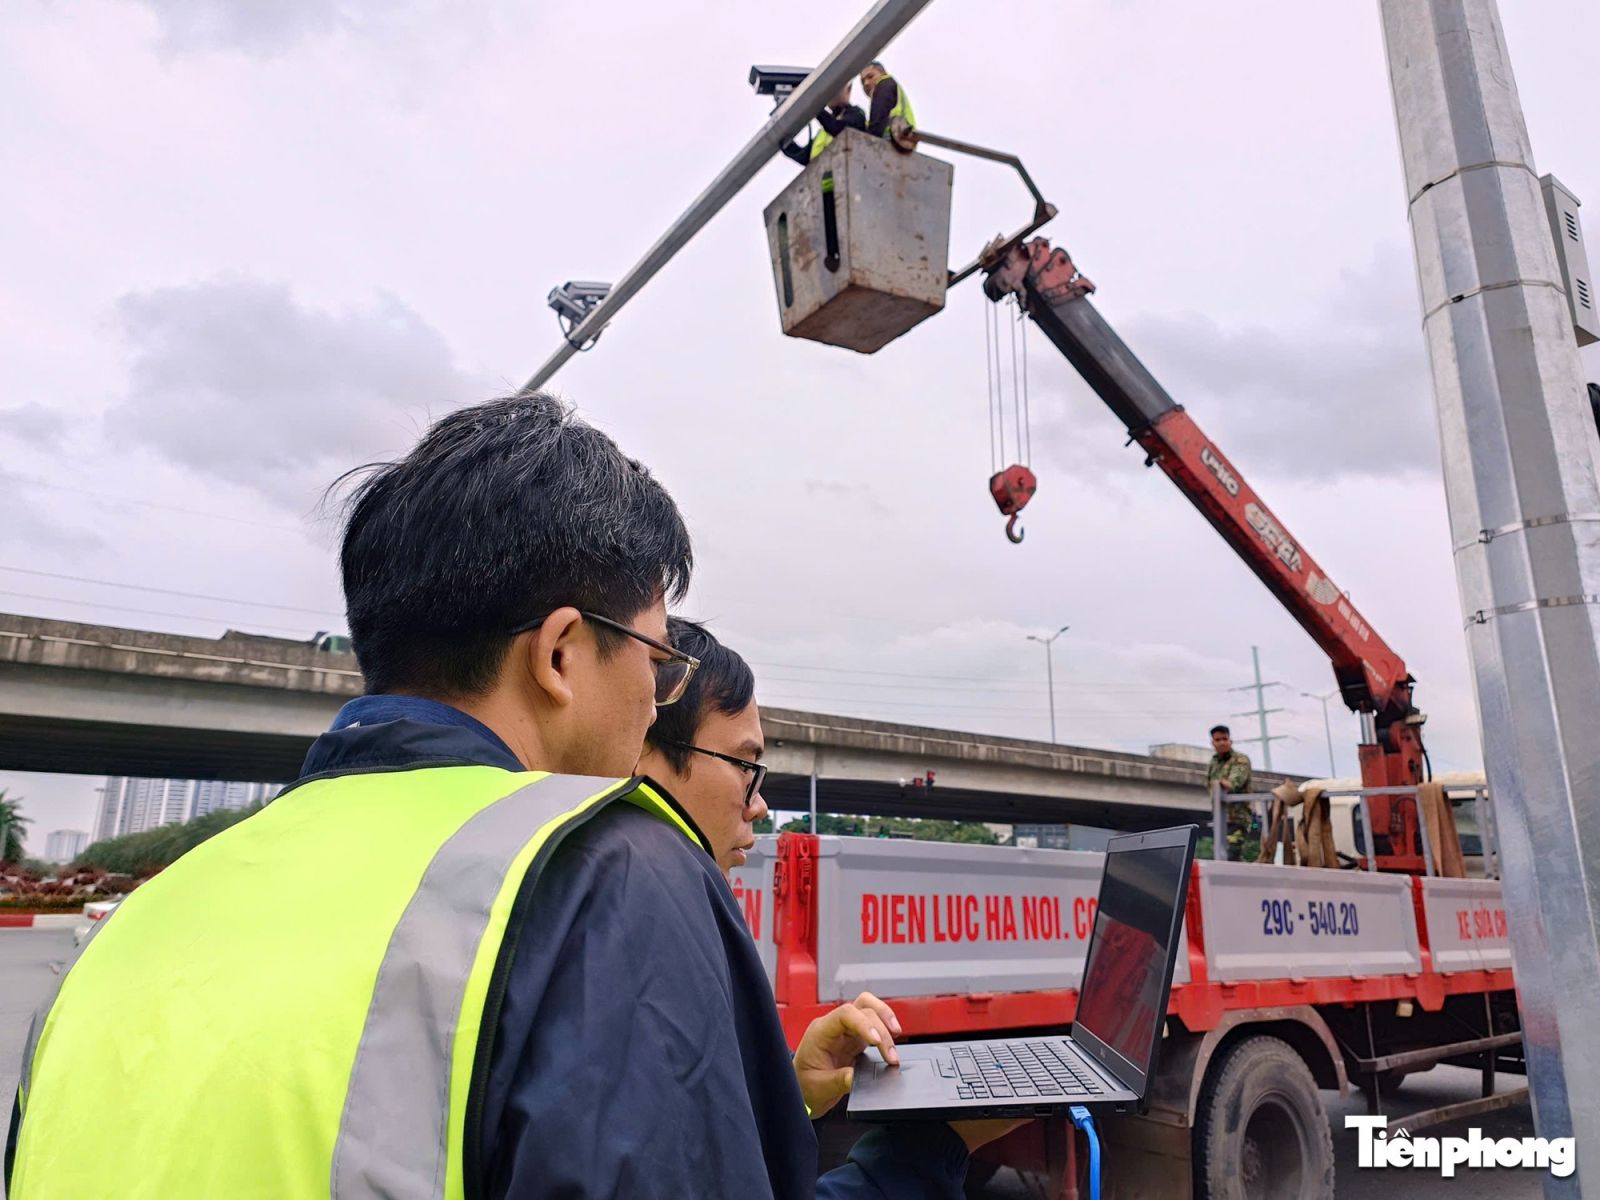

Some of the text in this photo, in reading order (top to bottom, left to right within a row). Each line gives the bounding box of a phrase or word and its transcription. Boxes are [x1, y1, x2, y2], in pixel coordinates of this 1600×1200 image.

[933, 895, 979, 942] LUC
[985, 896, 1018, 941] HA
[1261, 899, 1294, 936] 29C
[1308, 901, 1359, 936] 540.20
